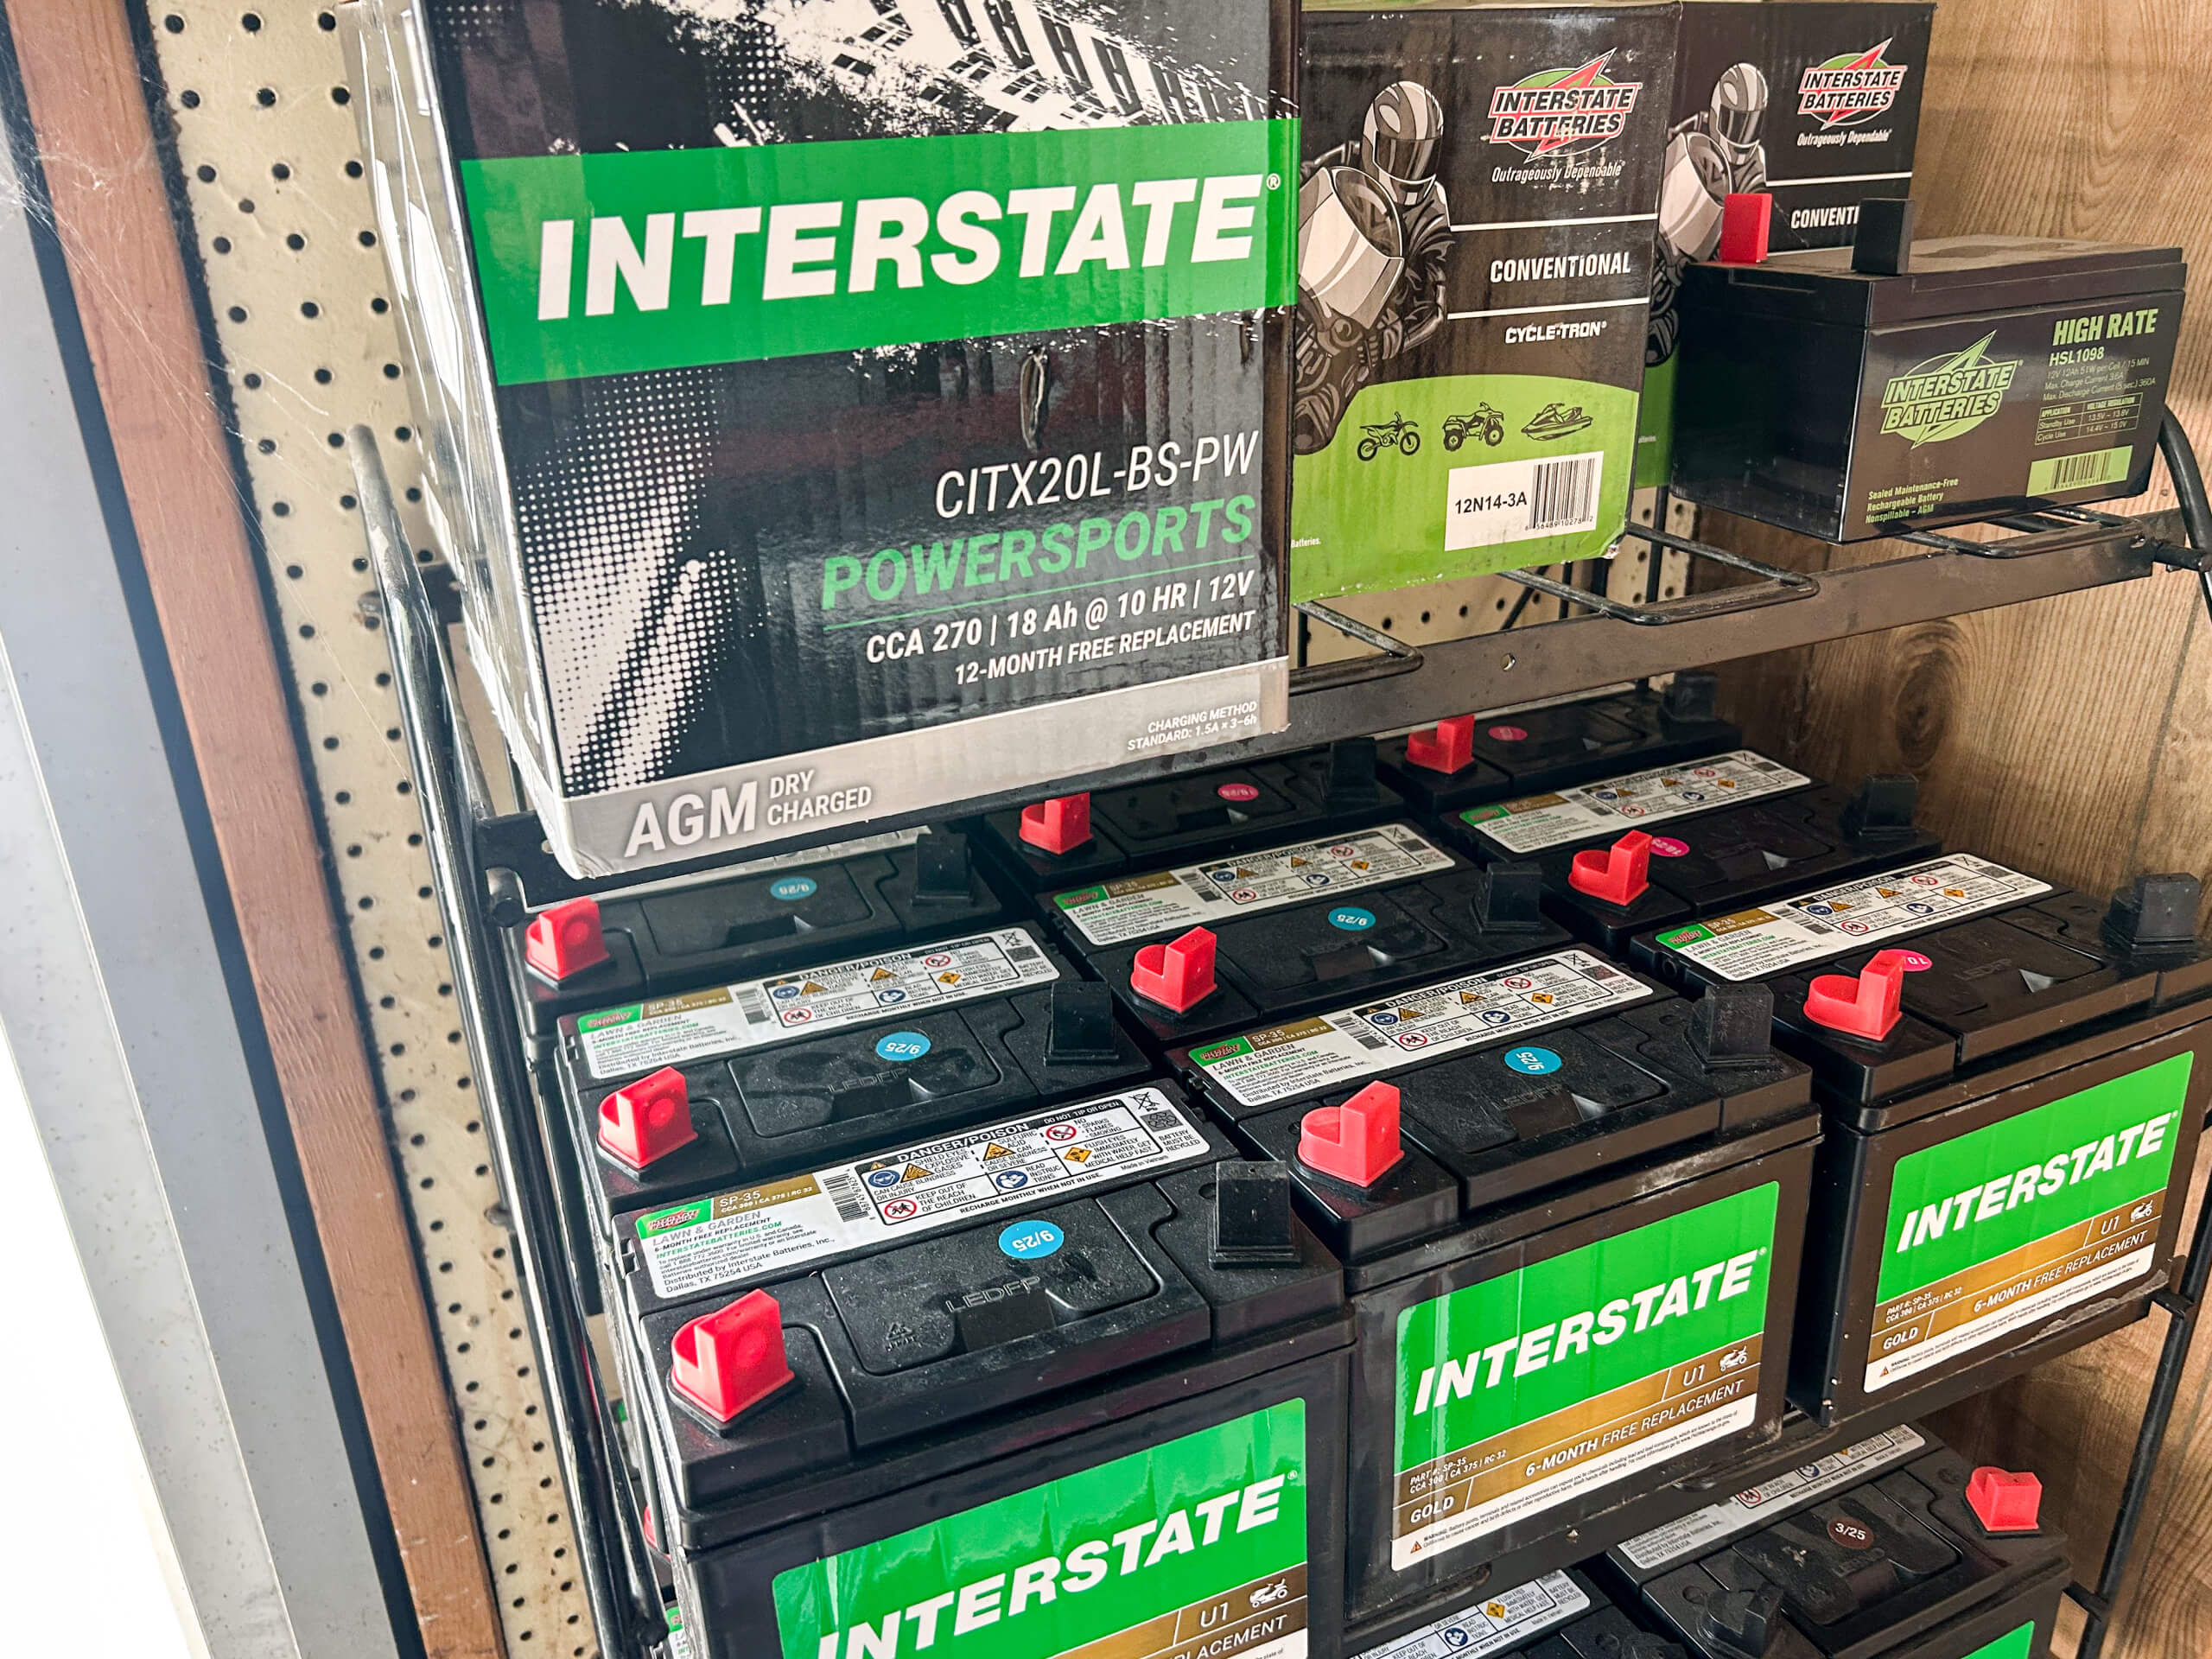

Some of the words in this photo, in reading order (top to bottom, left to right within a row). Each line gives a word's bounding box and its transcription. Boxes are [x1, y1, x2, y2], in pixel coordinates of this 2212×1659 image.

[1804, 71, 1900, 89] INTERSTATE
[1495, 88, 1632, 114] INTERSTATE
[1803, 91, 1891, 109] BATTERIES
[1497, 113, 1622, 138] BATTERIES
[1797, 131, 1847, 148] Outrageously
[1491, 163, 1562, 184] Outrageously
[1563, 162, 1622, 180] Dependable
[1790, 206, 1859, 229] CONVENTI
[1490, 251, 1631, 283] CONVENTIONAL
[2052, 315, 2104, 346] HIGH
[2106, 308, 2158, 339] RATE
[2049, 346, 2105, 367] HSL1098
[1885, 367, 2014, 404] INTERSTATE
[1885, 391, 2001, 429] BATTERIES
[936, 431, 1259, 518] CITX20L-BS-PW
[1868, 487, 1893, 500] Sealed
[1895, 478, 1959, 496] Maintenance-Free
[1455, 492, 1527, 514] 12N14-3A
[1867, 496, 1916, 512] Rechargeable
[1917, 492, 1944, 504] Battery
[1917, 504, 1935, 515] AGM
[821, 495, 1255, 610] POWERSPORTS
[867, 631, 925, 664] CCA
[933, 618, 982, 652] 270
[1007, 608, 1037, 637] 18
[1043, 601, 1078, 632] Ah
[1084, 597, 1109, 630] @
[1119, 590, 1145, 618] 10
[1152, 582, 1187, 613] HR
[1209, 569, 1255, 602] 12V
[956, 646, 1063, 685] 12-MONTH
[1068, 635, 1115, 664] FREE
[1120, 610, 1255, 654] REPLACEMENT
[1147, 711, 1207, 734] CHARGING
[1209, 701, 1257, 721] METHOD
[1127, 729, 1192, 751] STANDARD:
[1196, 723, 1220, 738] 1.5A
[769, 769, 814, 801] DRY
[766, 785, 873, 827] CHARGED
[624, 779, 758, 857] AGM
[1336, 913, 1368, 926] 9/25
[1382, 976, 1489, 1007] DANGER/POISON
[885, 1041, 921, 1055] 9/25
[1210, 1057, 1245, 1071] LAWN
[1251, 1043, 1298, 1059] GARDEN
[1054, 1112, 1072, 1122] NOT
[1072, 1109, 1086, 1117] TIP
[1081, 1117, 1110, 1128] SPARKS
[996, 1129, 1038, 1145] SULFURIC
[1084, 1122, 1114, 1134] FLAMES
[1088, 1125, 1122, 1138] SMOKING
[1157, 1128, 1191, 1141] BATTERY
[895, 1122, 1030, 1163] DANGER/POISON
[1006, 1138, 1027, 1148] ACID
[1014, 1144, 1033, 1153] CAN
[1083, 1138, 1109, 1149] FLUSH
[1106, 1133, 1126, 1143] EYES
[1090, 1150, 1113, 1160] WITH
[1136, 1140, 1152, 1148] GET
[1093, 1137, 1140, 1154] IMMEDIATELY
[1162, 1136, 1184, 1147] MUST
[1164, 1138, 1201, 1153] RECYCLED
[914, 1153, 946, 1166] SHIELD
[924, 1153, 970, 1170] EXPLOSIVE
[933, 1161, 963, 1174] GASES
[982, 1156, 1008, 1167] CAUSE
[1007, 1146, 1048, 1160] BLINDNESS
[1025, 1161, 1046, 1172] READ
[1084, 1155, 1116, 1169] MEDICAL
[1115, 1150, 1135, 1160] HELP
[986, 1164, 1000, 1173] OR
[872, 1187, 890, 1196] CAN
[889, 1180, 915, 1192] CAUSE
[914, 1170, 957, 1185] BLINDNESS
[914, 1190, 938, 1201] KEEP
[937, 1185, 957, 1195] OUT
[957, 1181, 968, 1190] OF
[1897, 1112, 2171, 1254] INTERSTATE
[717, 1189, 762, 1208] SP-35
[918, 1197, 937, 1206] THE
[936, 1189, 965, 1201] REACH
[958, 1198, 1000, 1215] RECHARGE
[999, 1187, 1038, 1204] MONTHLY
[1035, 1181, 1061, 1193] WHEN
[1058, 1177, 1077, 1187] NOT
[1075, 1174, 1086, 1183] IN
[920, 1204, 934, 1212] OF
[651, 1228, 693, 1246] LAWN
[693, 1224, 706, 1235] &
[706, 1210, 763, 1231] GARDEN
[652, 1236, 692, 1252] 6-MONTH
[692, 1231, 714, 1242] FREE
[713, 1216, 772, 1236] REPLACEMENT
[2101, 1214, 2120, 1236] U1
[654, 1219, 784, 1260] INTERSTATEBATTERIES.COM
[1012, 1230, 1055, 1251] 9/25
[663, 1267, 714, 1287] Distributed
[714, 1263, 727, 1273] by
[727, 1251, 772, 1269] Interstate
[772, 1239, 815, 1256] Batteries,
[1974, 1277, 2032, 1314] 6-MONTH
[2034, 1265, 2063, 1287] FREE
[2064, 1230, 2148, 1275] REPLACEMENT
[664, 1278, 697, 1294] Dallas,
[697, 1274, 712, 1285] TX
[712, 1266, 742, 1281] 75254
[741, 1260, 764, 1273] USA
[1413, 1249, 1758, 1416] INTERSTATE
[1882, 1325, 1919, 1351] GOLD
[1682, 1364, 1705, 1387] U1
[1525, 1437, 1598, 1477] 6-MONTH
[1601, 1423, 1637, 1448] FREE
[1641, 1379, 1744, 1432] REPLACEMENT
[1409, 1480, 1427, 1495] CCA
[1449, 1466, 1461, 1478] CA
[1462, 1459, 1478, 1473] 375
[1484, 1452, 1496, 1465] RC
[1410, 1469, 1431, 1485] PART
[1442, 1455, 1467, 1472] SP-35
[1410, 1494, 1455, 1523] GOLD
[1834, 1522, 1866, 1541] 3/25
[817, 1474, 1284, 1659] INTERSTATE
[1200, 1602, 1230, 1628] U1
